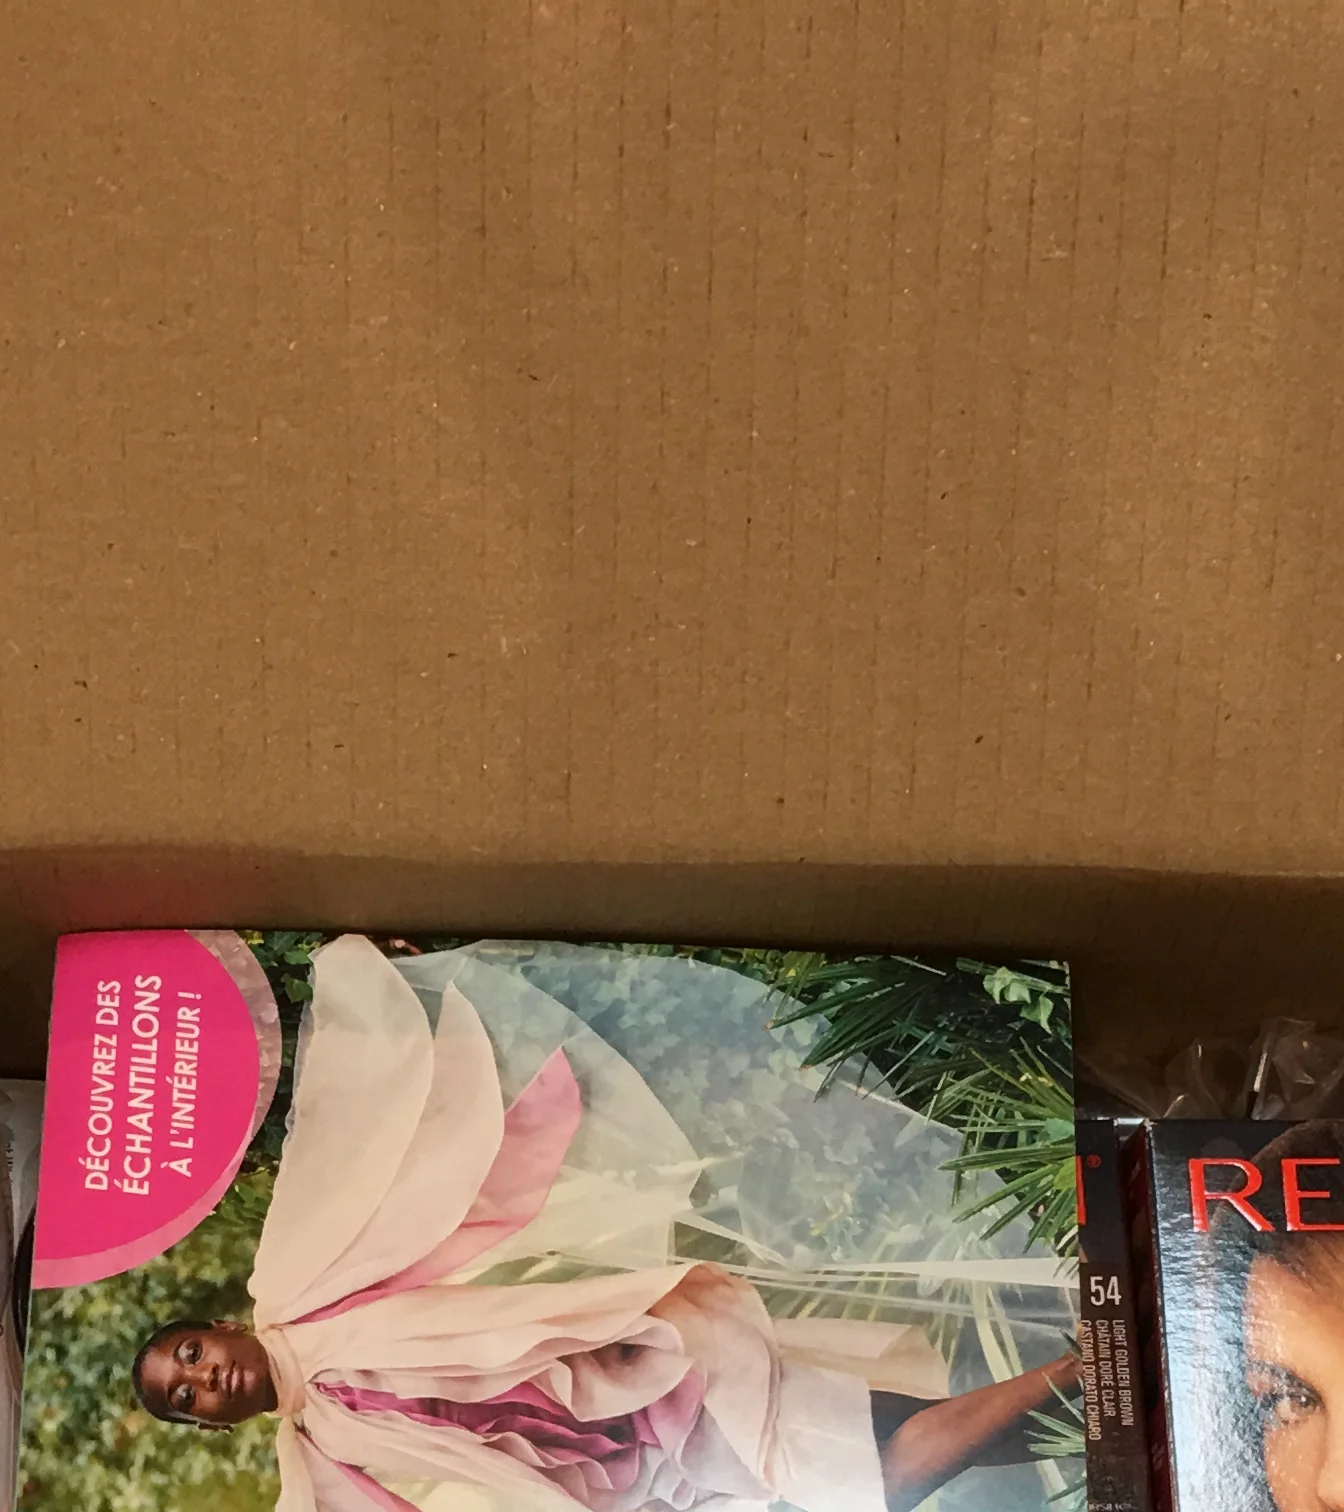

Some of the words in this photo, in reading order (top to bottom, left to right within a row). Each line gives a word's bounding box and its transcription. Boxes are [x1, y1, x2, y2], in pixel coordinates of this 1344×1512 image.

[95, 980, 121, 1026] DES
[177, 991, 202, 1001] !
[113, 974, 162, 1196] ÉCHANTILLONS
[165, 1006, 201, 1150] L'INTÉRIEUR
[78, 1033, 118, 1191] DÉCOUVREZ
[160, 1157, 193, 1178] À
[1090, 1276, 1122, 1306] 54
[1112, 1319, 1127, 1347] LIGHT
[1082, 1364, 1099, 1403] DORATO
[1115, 1349, 1130, 1387] GOLDEN
[1101, 1389, 1117, 1418] CLAIR
[1118, 1389, 1134, 1426] BROWN
[1086, 1405, 1102, 1441] CHIARO
